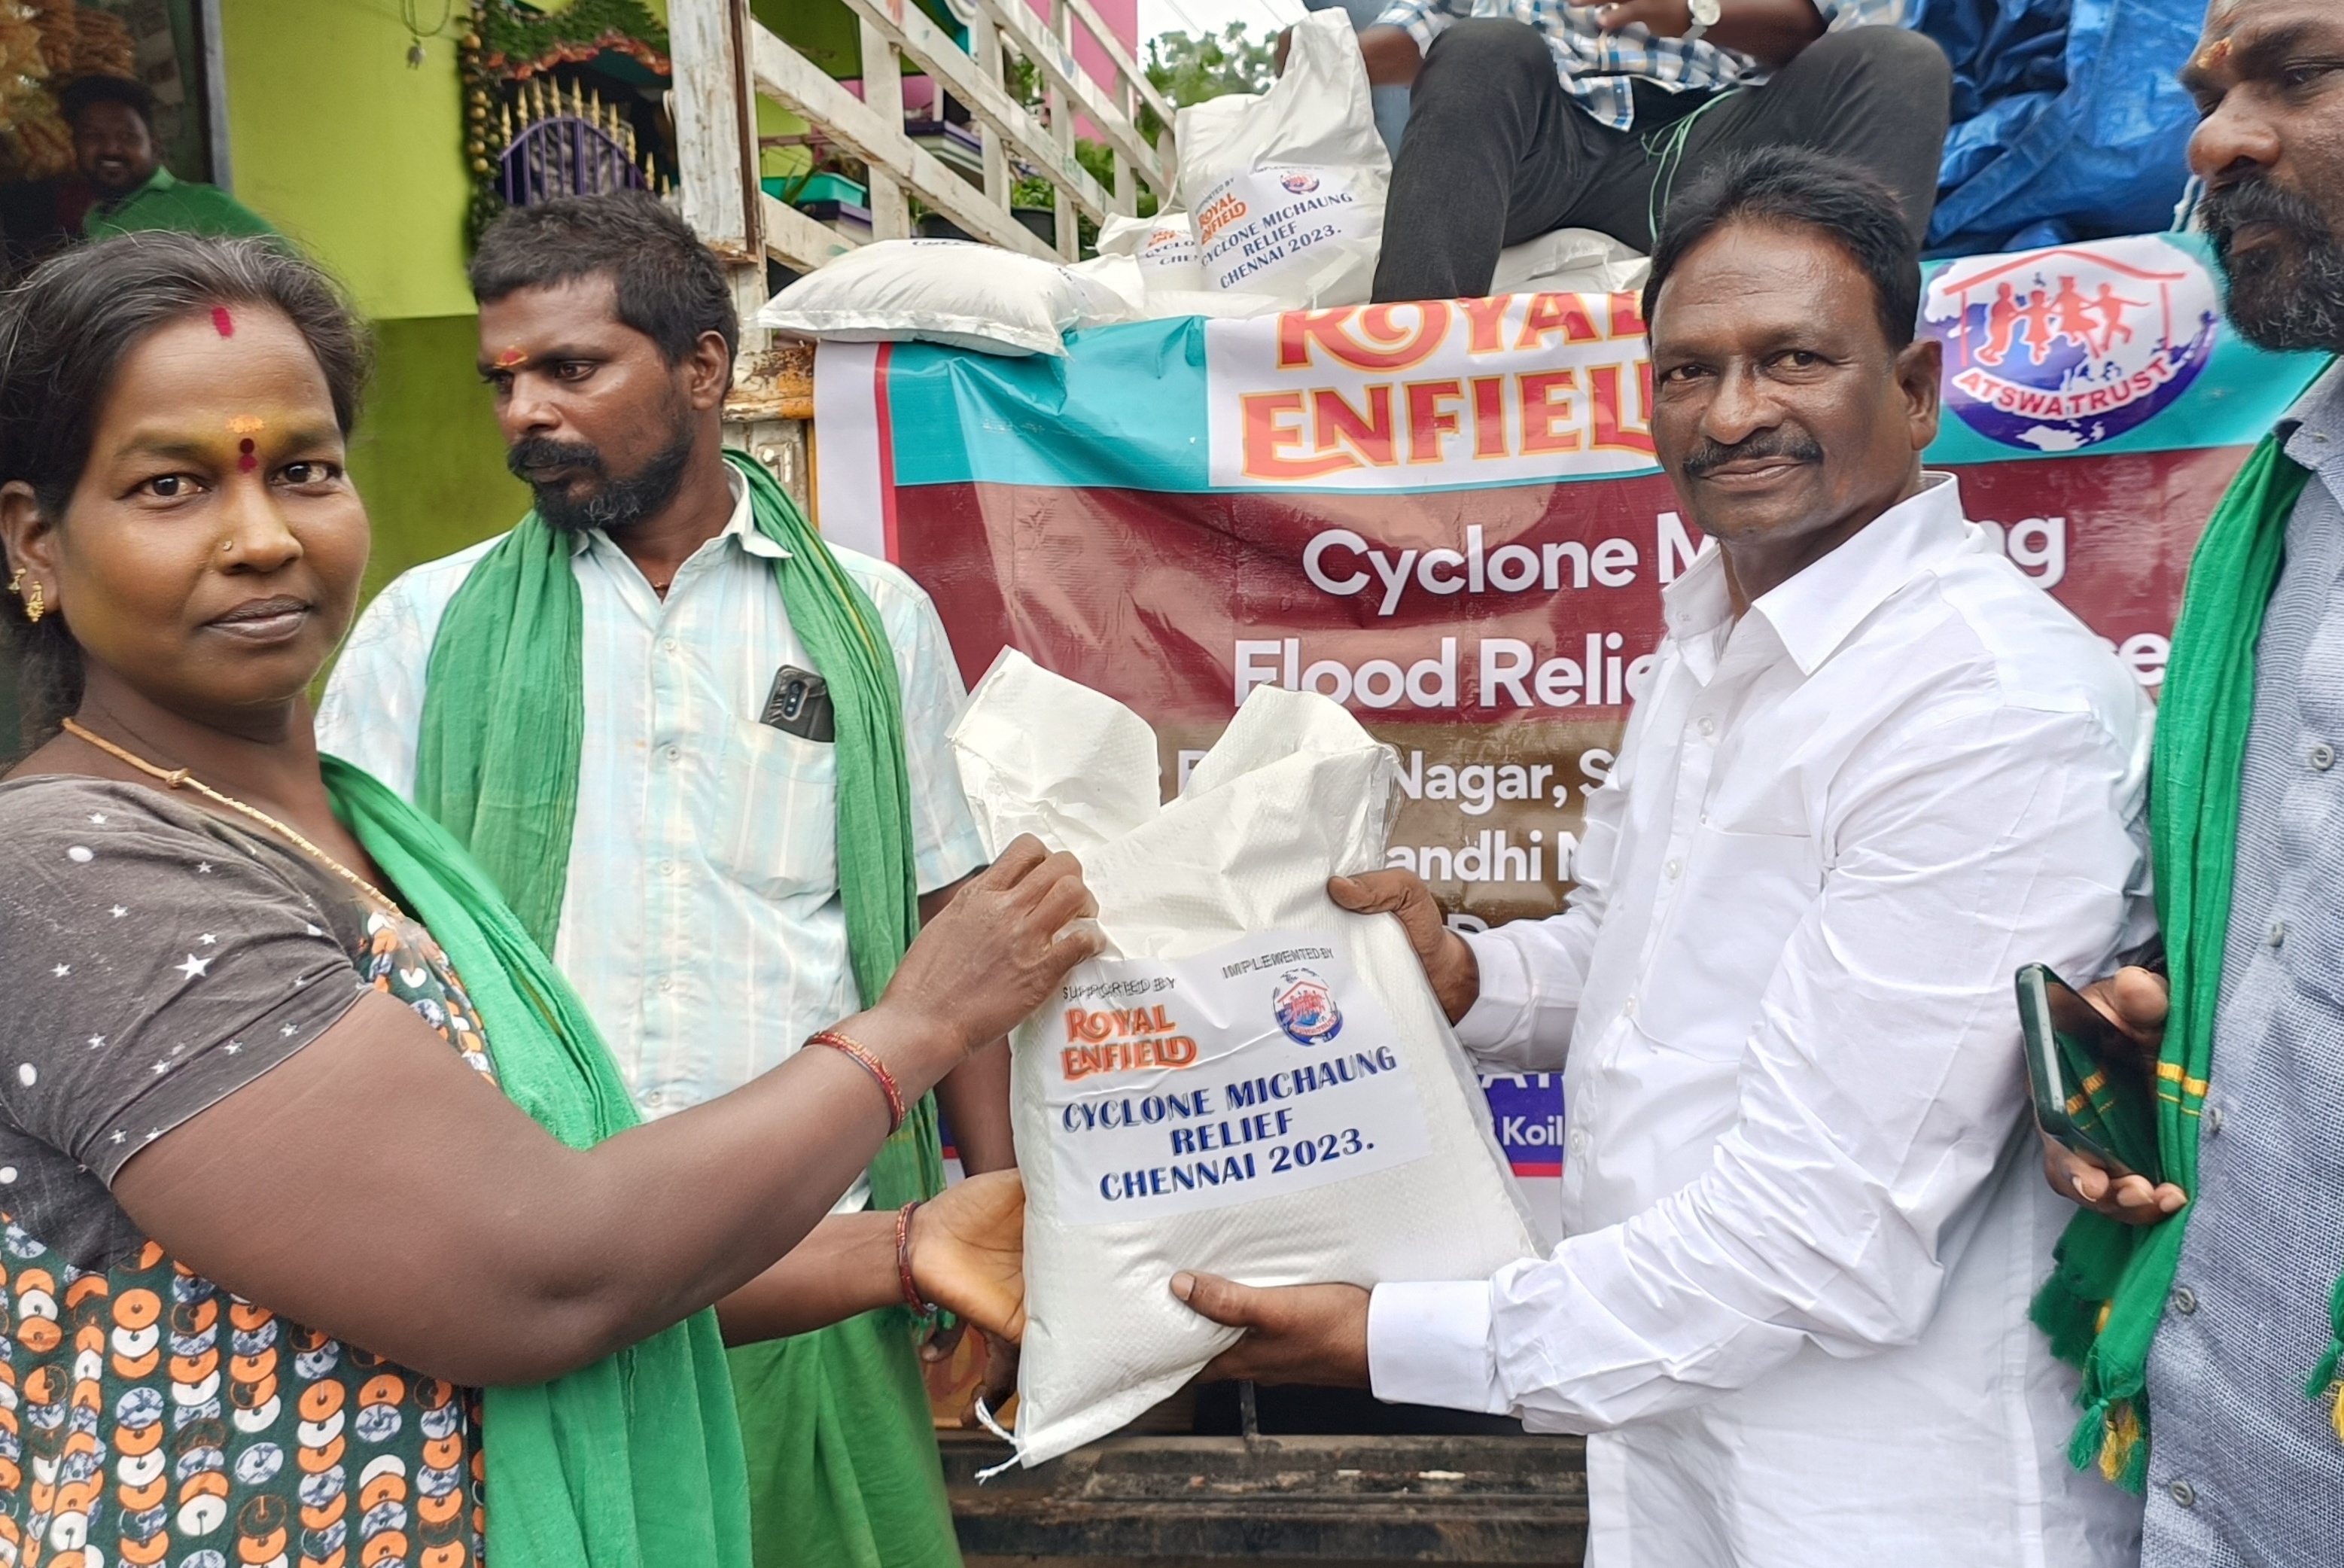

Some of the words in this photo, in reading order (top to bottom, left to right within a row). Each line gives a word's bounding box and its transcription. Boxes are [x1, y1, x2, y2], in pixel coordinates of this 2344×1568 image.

[1201, 222, 1260, 267] CYCLONE
[1262, 193, 1353, 230] MICHAUNG
[1220, 246, 1284, 289] CHENNAI
[1288, 224, 1342, 253] 2023.
[1243, 221, 1298, 257] RELIEF
[1959, 357, 2173, 419] ATSWATRUST
[1303, 525, 1638, 616] Cyclone
[1234, 638, 1456, 708] Flood
[1393, 751, 1567, 815] Nagar,
[1063, 979, 1150, 1003] SUPPORTED
[1153, 976, 1176, 992] BY
[1064, 1004, 1177, 1044] ROYAL
[1060, 1036, 1198, 1081] ENFIELD
[1063, 1088, 1214, 1133] CYCLONE
[1225, 1046, 1397, 1111] MICHAUNG
[1170, 1108, 1292, 1155] RELIEF
[1502, 1116, 1563, 1146] Koil
[1100, 1153, 1256, 1201] CHENNAI
[1269, 1128, 1374, 1174] 2023.
